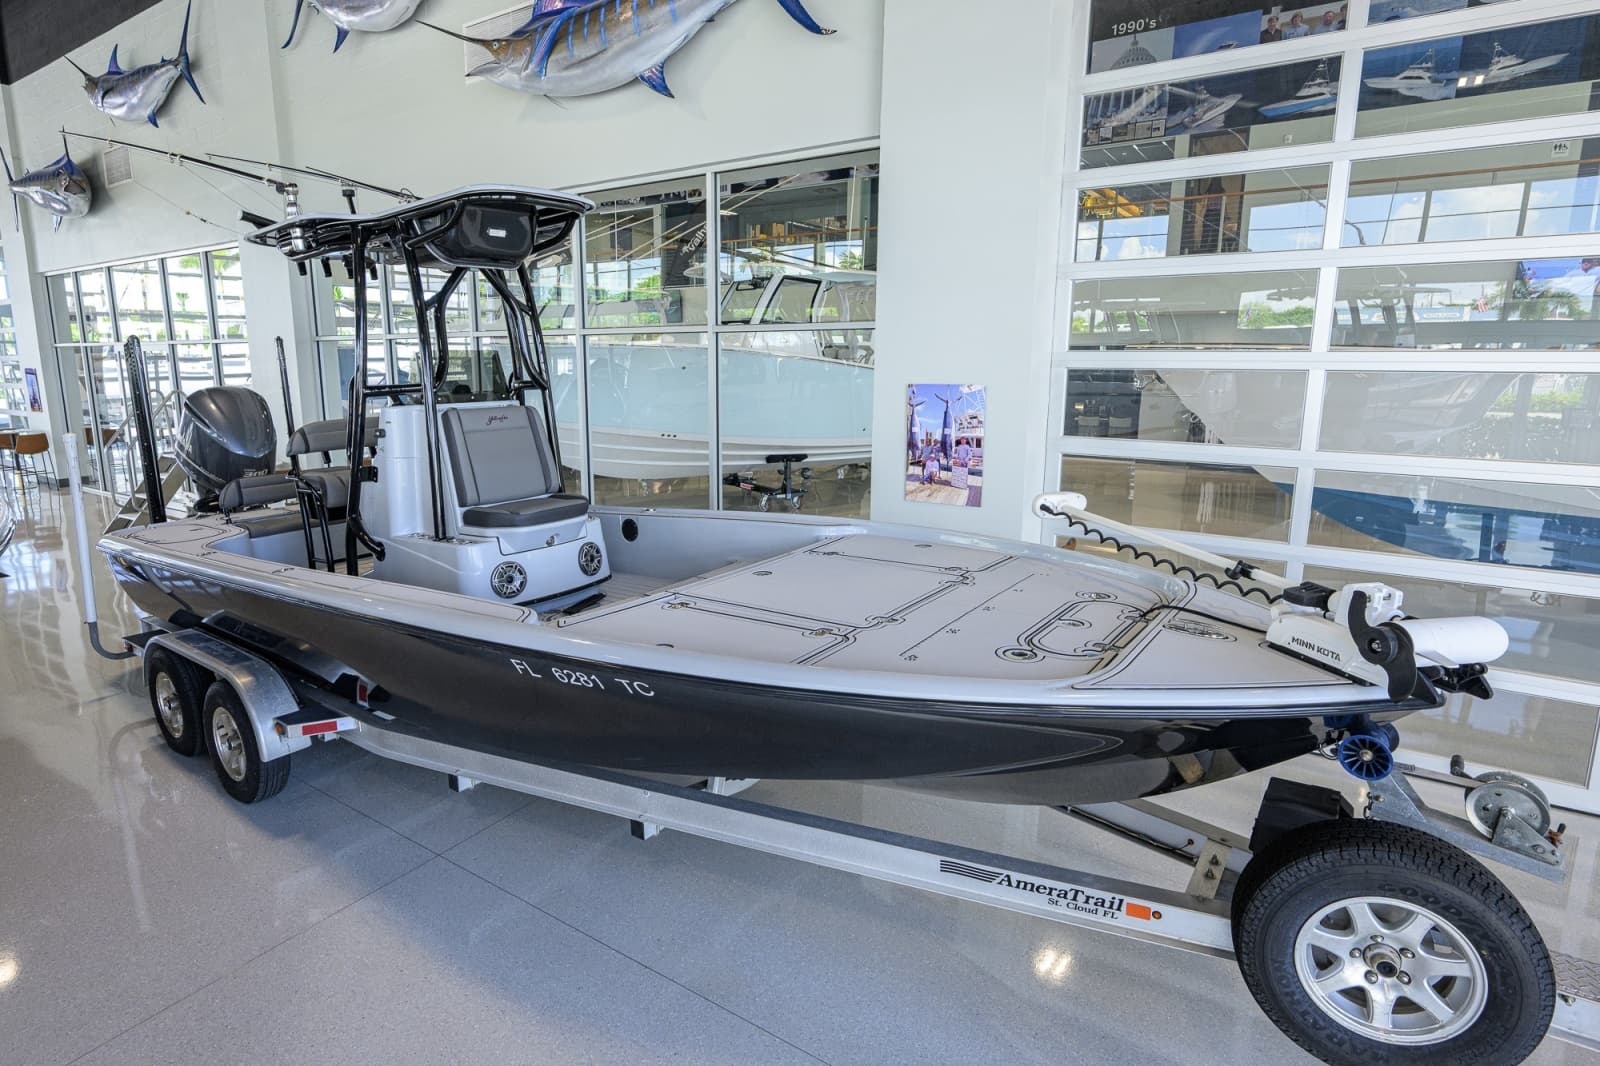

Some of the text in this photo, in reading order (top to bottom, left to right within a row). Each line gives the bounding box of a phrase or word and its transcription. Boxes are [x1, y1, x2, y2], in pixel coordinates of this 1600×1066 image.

[1111, 17, 1157, 36] 1990's
[688, 224, 707, 251] Valh
[1291, 636, 1341, 662] MINN KOTA
[510, 658, 655, 697] FL 6281 TC
[998, 874, 1125, 912] AmeraTrail
[1047, 897, 1119, 920] St. Cloud FL
